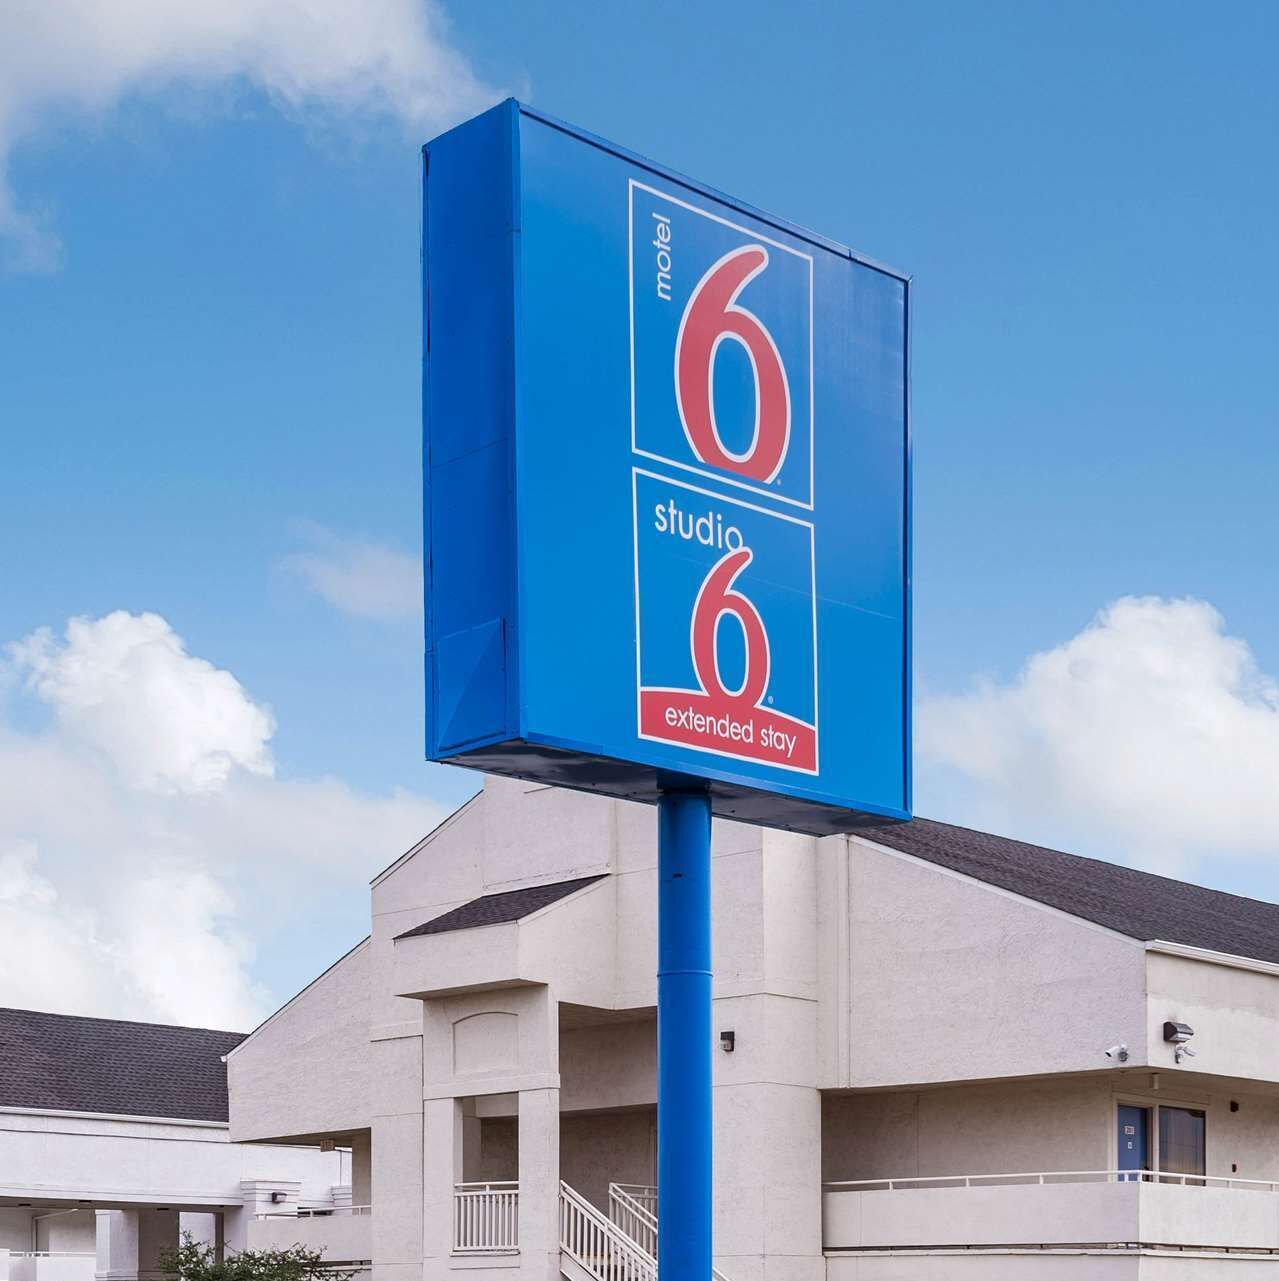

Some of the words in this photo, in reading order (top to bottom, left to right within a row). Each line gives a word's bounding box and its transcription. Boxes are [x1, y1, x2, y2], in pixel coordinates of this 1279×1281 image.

[652, 213, 671, 301] motel
[674, 244, 792, 484] 6
[655, 499, 743, 552] studio
[690, 546, 771, 707] 6
[665, 706, 754, 744] extended
[760, 725, 797, 758] stay
